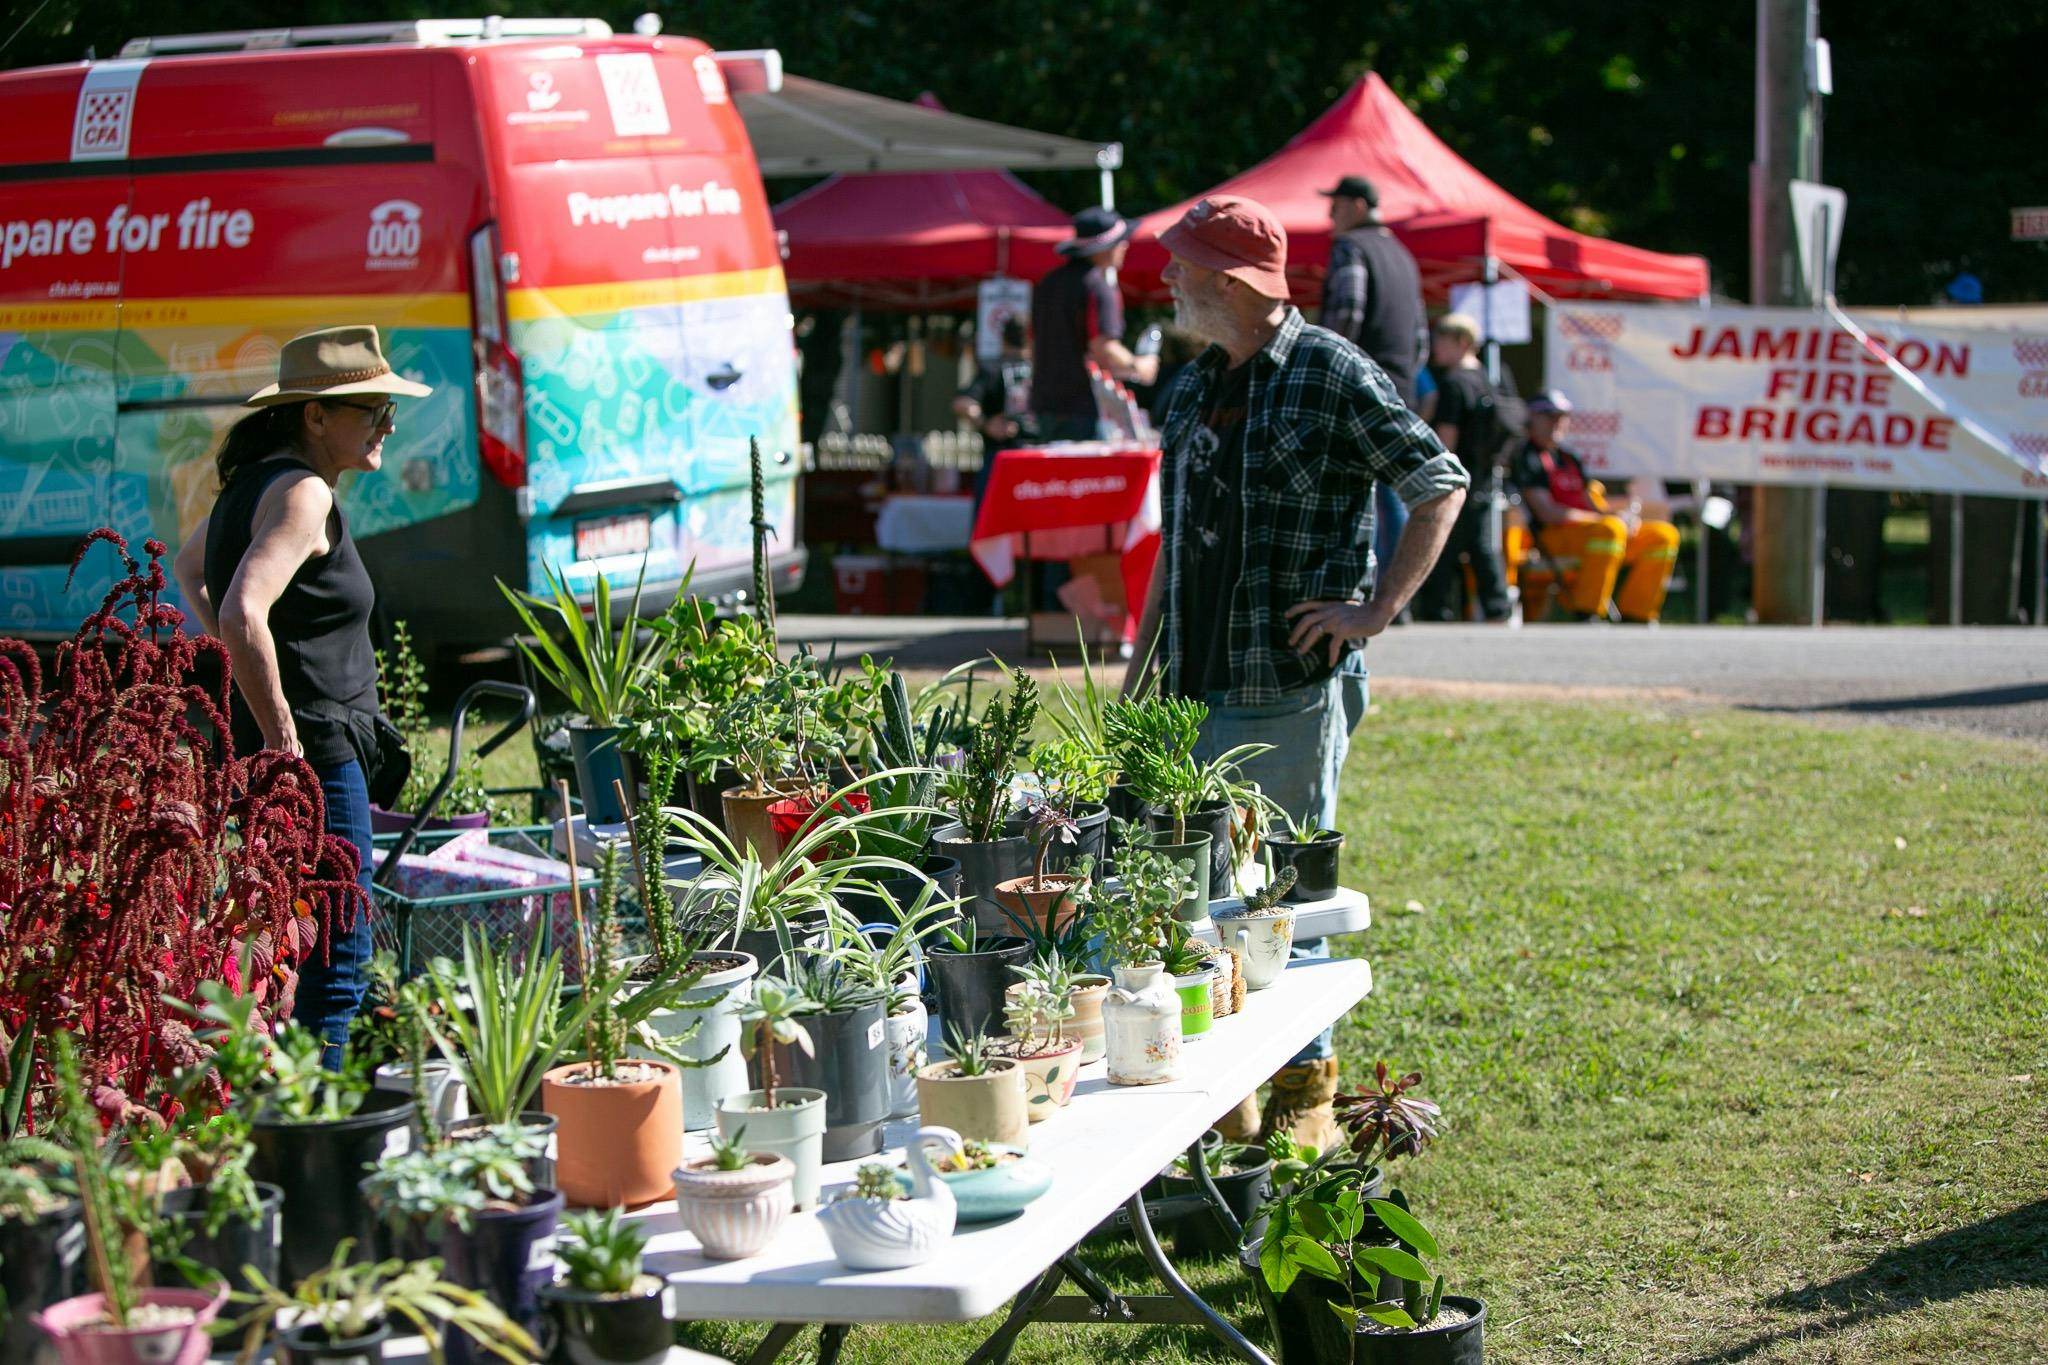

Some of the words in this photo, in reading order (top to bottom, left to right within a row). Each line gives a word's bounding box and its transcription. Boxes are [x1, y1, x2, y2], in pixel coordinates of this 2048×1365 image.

[84, 127, 118, 145] CFA
[567, 192, 667, 229] Prepare
[669, 183, 704, 217] for
[703, 180, 741, 215] fire
[0, 217, 97, 269] pare
[105, 204, 170, 253] for
[177, 196, 254, 250] fire
[367, 222, 421, 257] 000
[1766, 368, 1894, 406] FIRE
[1694, 405, 1955, 450] BRIGADE
